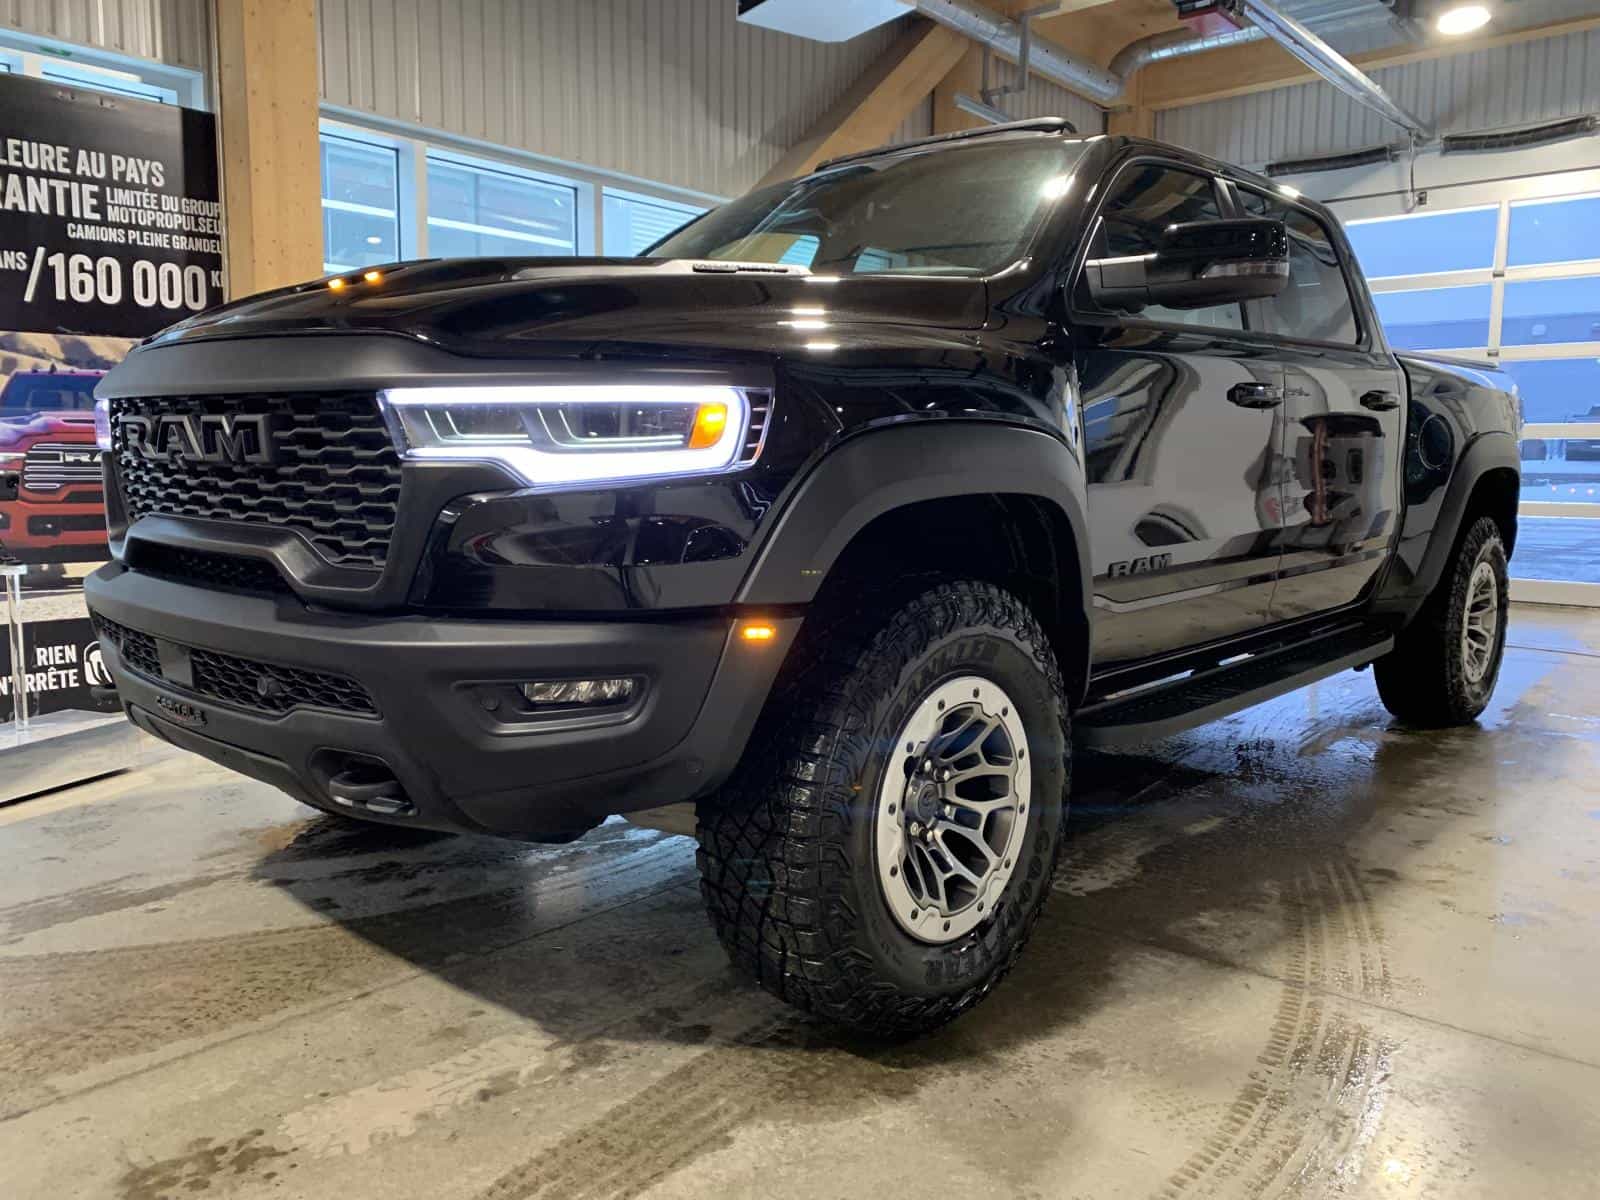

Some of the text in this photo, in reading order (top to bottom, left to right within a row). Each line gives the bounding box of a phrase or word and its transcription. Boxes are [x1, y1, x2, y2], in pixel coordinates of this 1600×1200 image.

[76, 149, 106, 179] AU
[111, 155, 165, 187] PAYS
[0, 173, 101, 220] ANTIE
[106, 186, 159, 208] LIMITÉE
[161, 195, 179, 213] DU
[67, 223, 126, 244] CAMIONS
[128, 231, 170, 249] PLEINE
[132, 260, 207, 311] 000
[211, 270, 223, 288] K
[119, 414, 266, 463] RAM
[1108, 553, 1172, 578] RAM
[36, 644, 77, 667] RIEN
